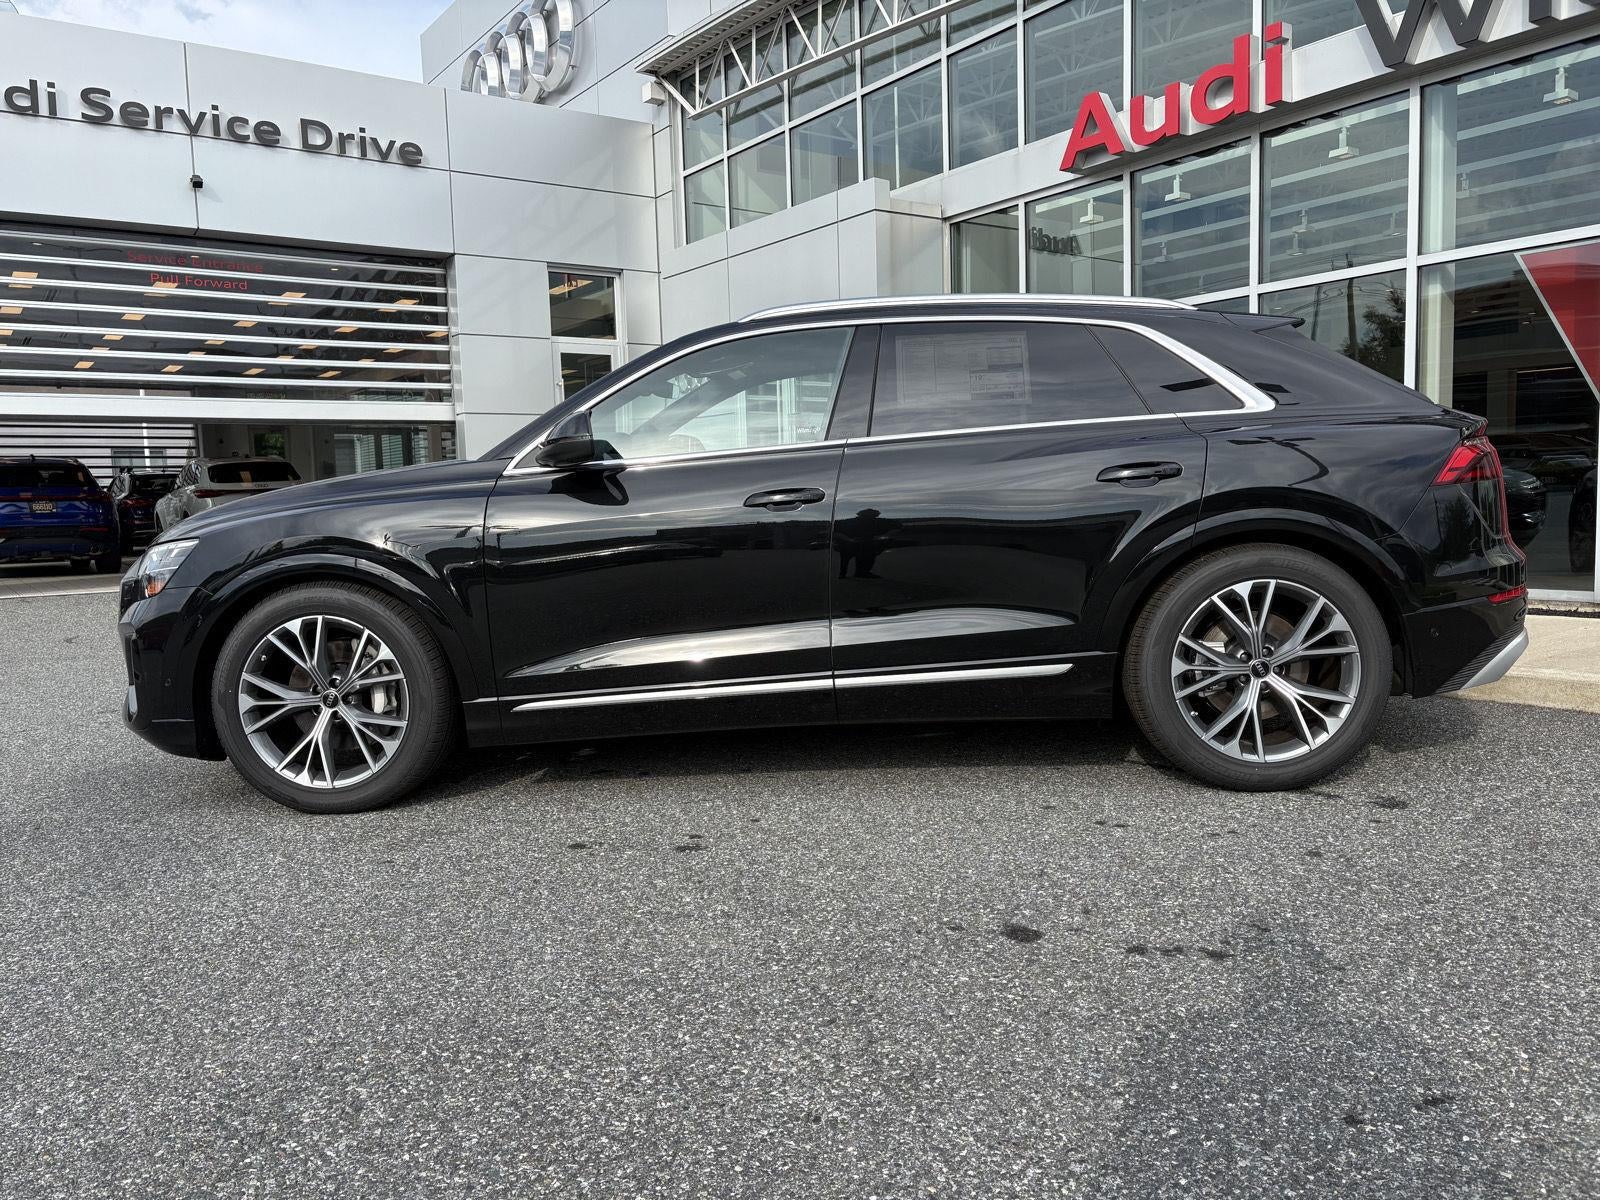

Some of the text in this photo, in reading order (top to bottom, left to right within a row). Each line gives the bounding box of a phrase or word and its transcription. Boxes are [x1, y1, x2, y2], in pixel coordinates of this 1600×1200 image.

[1060, 22, 1293, 172] Audi
[80, 86, 282, 145] Service
[300, 117, 424, 165] Drive
[127, 251, 263, 272] Service Entrance
[150, 272, 248, 290] Pull Forward
